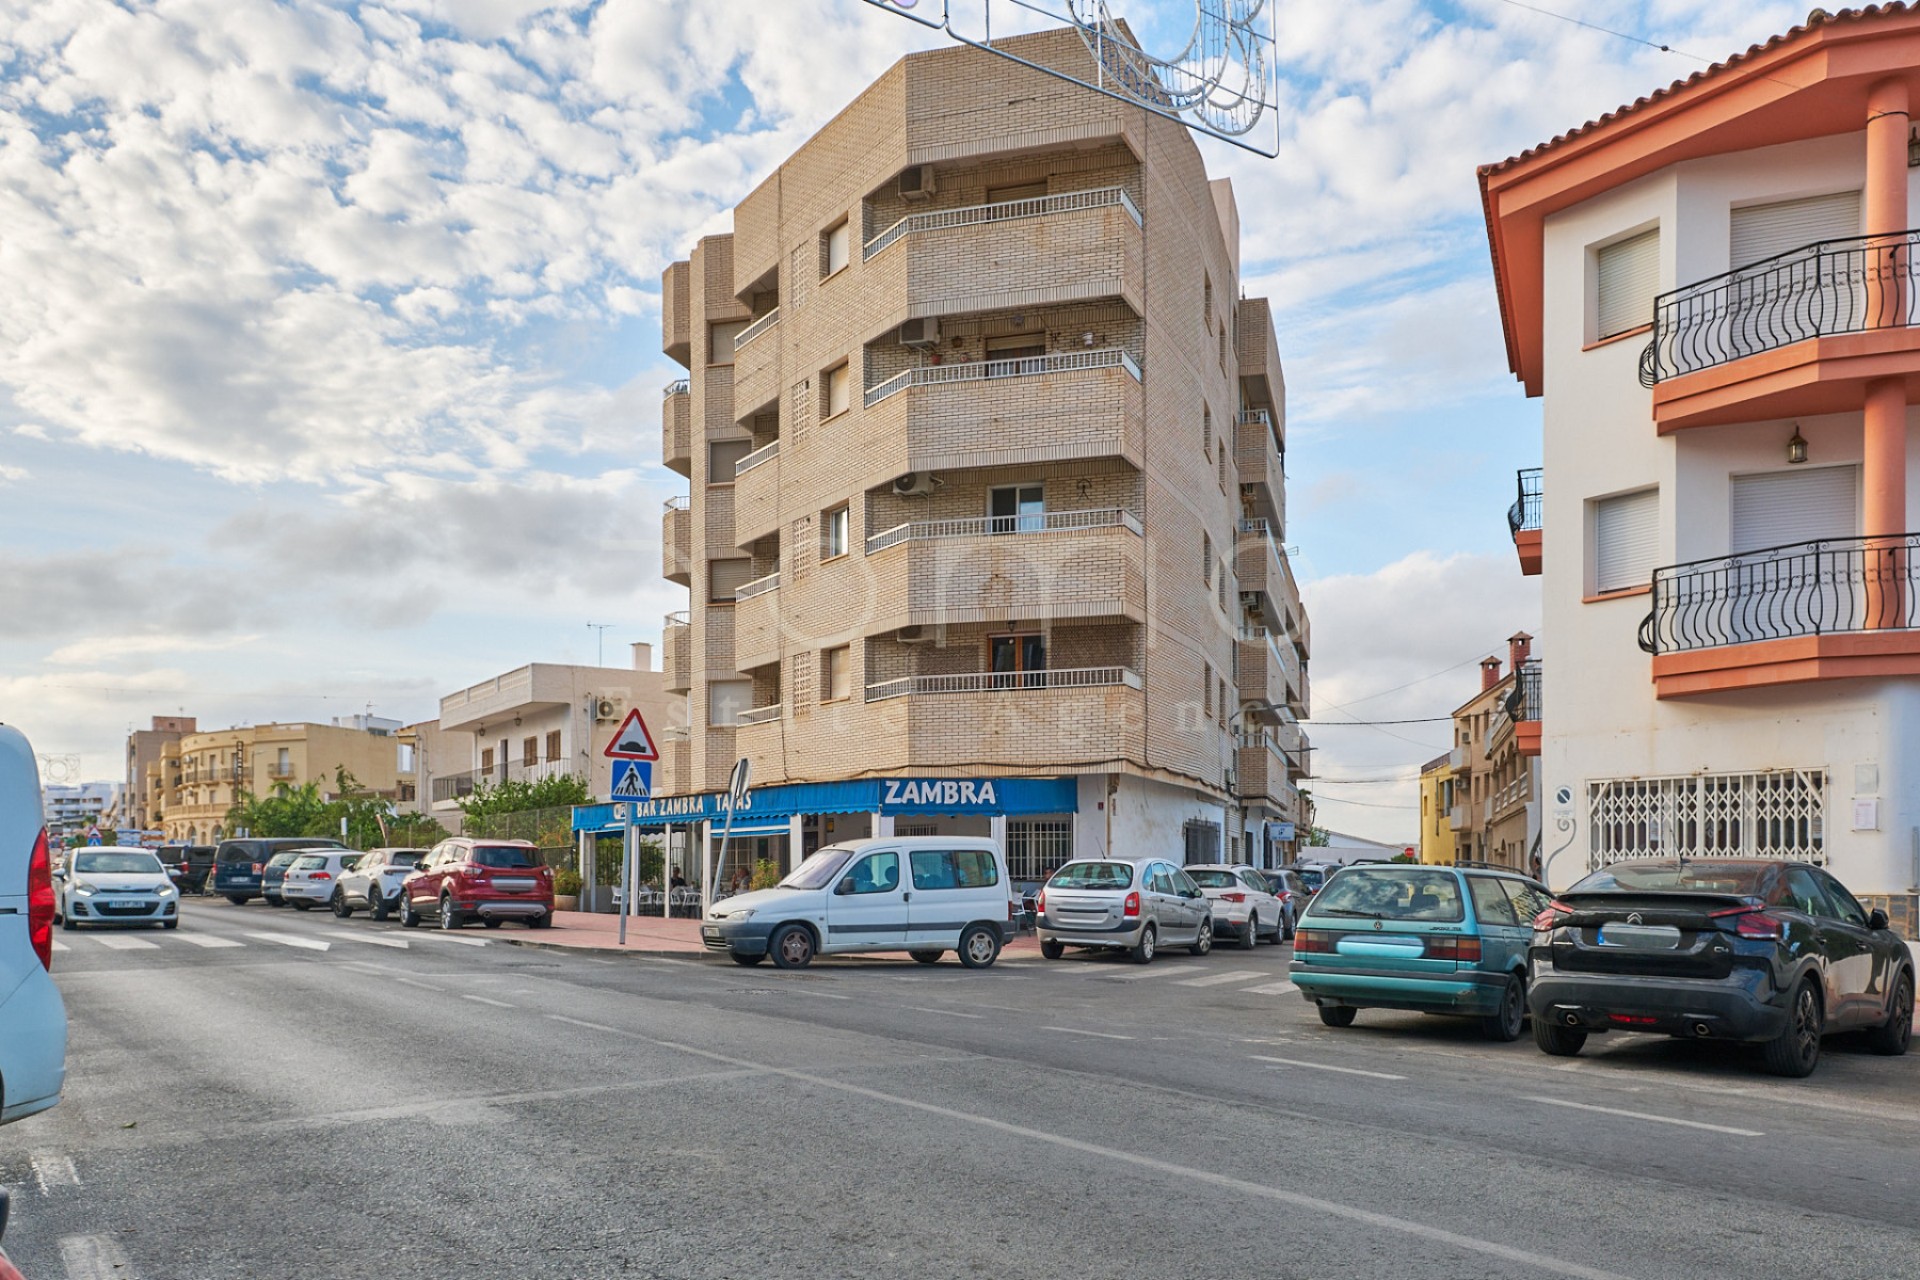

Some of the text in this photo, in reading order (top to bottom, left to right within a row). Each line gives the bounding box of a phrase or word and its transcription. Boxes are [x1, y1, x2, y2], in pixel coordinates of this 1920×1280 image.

[637, 799, 657, 818] BAR
[659, 795, 704, 816] ZAMBRA
[715, 791, 752, 812] TAAS
[884, 780, 996, 805] ZAMBRA
